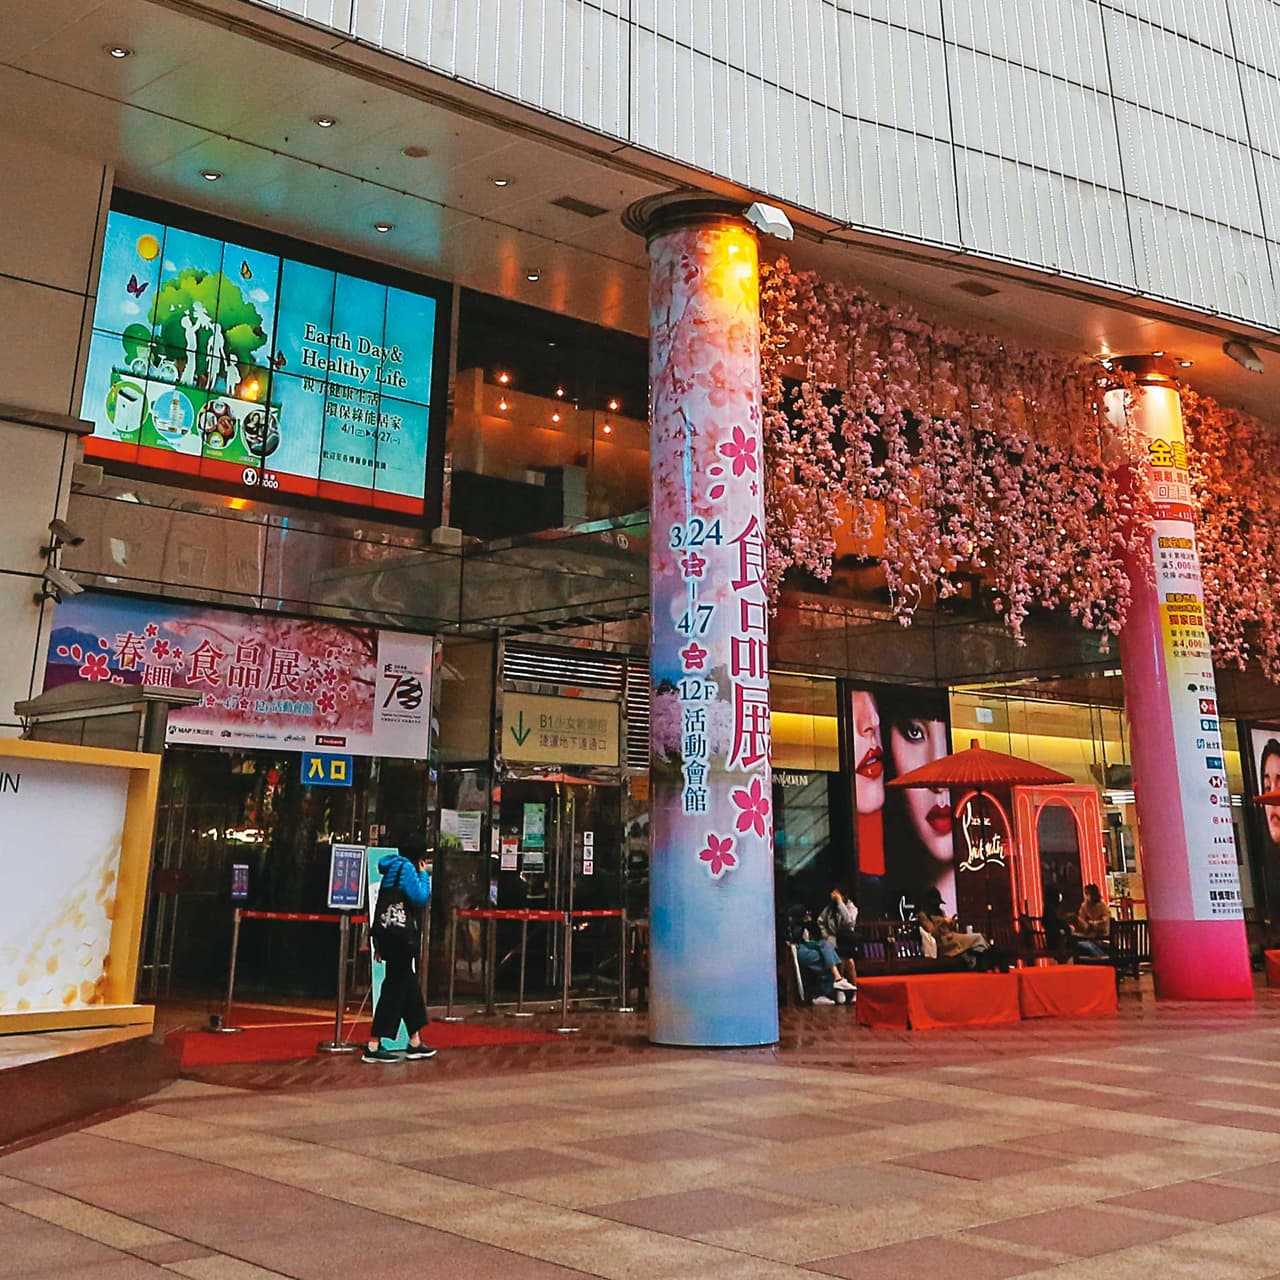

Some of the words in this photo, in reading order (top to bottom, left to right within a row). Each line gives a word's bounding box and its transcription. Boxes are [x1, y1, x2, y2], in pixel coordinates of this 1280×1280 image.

[304, 323, 352, 351] Earth
[302, 348, 370, 384] Healthy
[375, 366, 407, 389] Life
[671, 519, 722, 548] 3/24
[677, 605, 714, 634] 4/7
[185, 639, 302, 694] 食品展
[679, 681, 715, 701] 12F
[540, 714, 553, 729] B1
[307, 757, 347, 781] 入口
[683, 707, 707, 813] 活動會館
